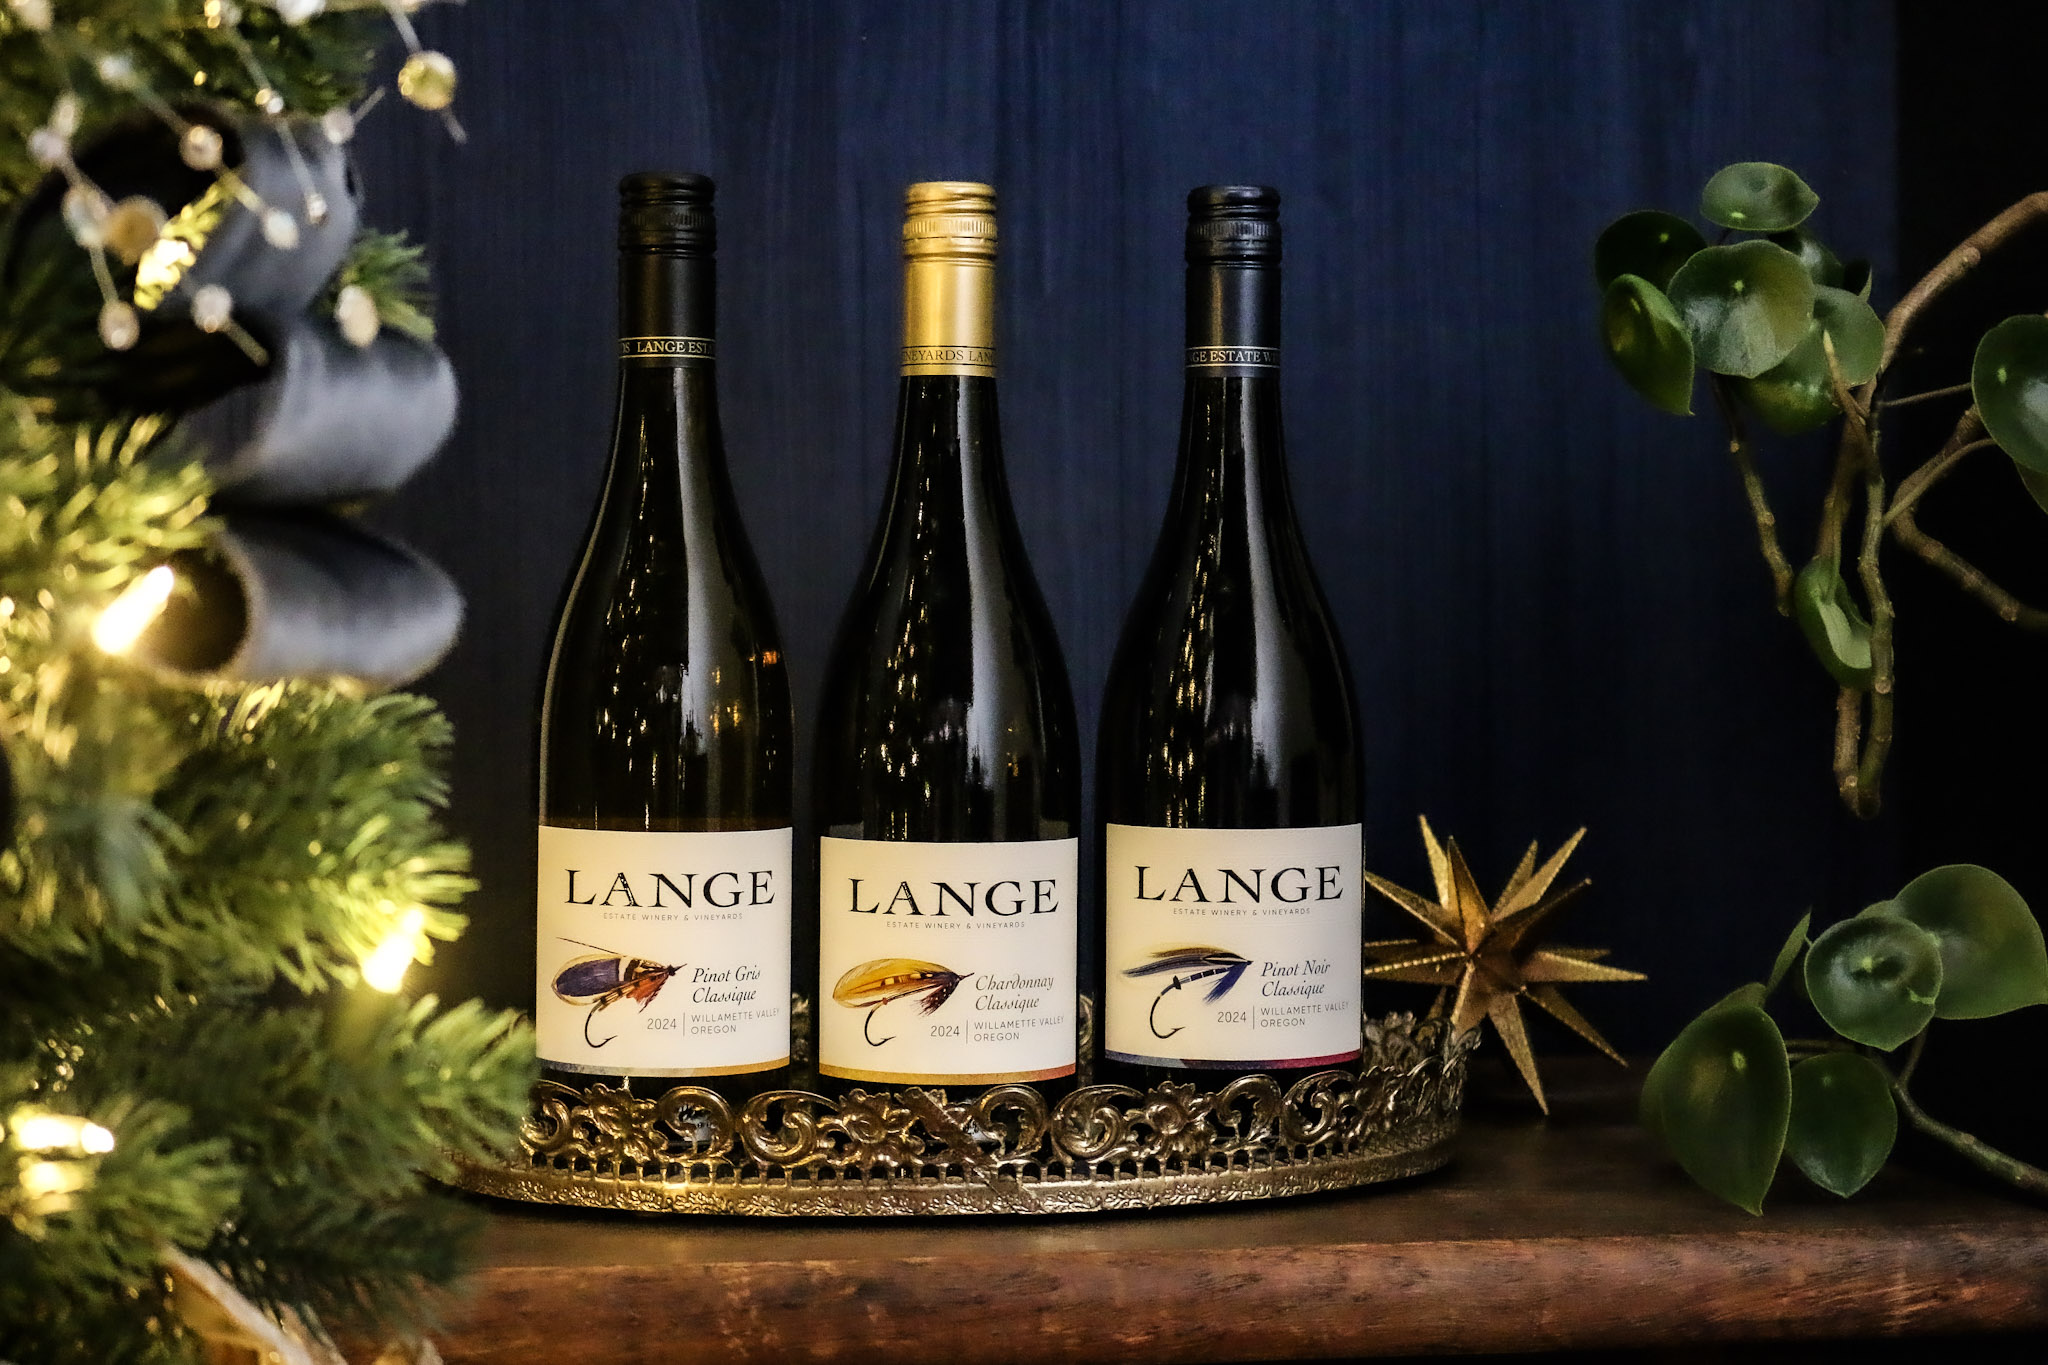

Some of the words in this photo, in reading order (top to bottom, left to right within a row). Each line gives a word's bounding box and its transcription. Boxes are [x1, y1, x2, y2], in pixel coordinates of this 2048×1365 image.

[637, 340, 686, 353] LANGE
[1210, 350, 1260, 362] ESTATE
[564, 868, 776, 908] LANGE
[1134, 865, 1343, 904] LANGE
[848, 878, 1059, 916] LANGE
[603, 912, 636, 921] ESTATE
[642, 913, 679, 922] WINERY
[694, 912, 743, 921] VINEYARDS
[1173, 908, 1206, 916] ESTATE
[1211, 908, 1247, 916] WINERY
[1252, 908, 1258, 916] &
[1262, 908, 1311, 916] VINEYARDS
[886, 921, 920, 929] ESTATE
[925, 922, 961, 930] WINERY
[966, 922, 972, 930] &
[976, 921, 1026, 929] VINEYARDS
[692, 967, 731, 984] Pinot
[735, 964, 761, 982] Gris
[1261, 960, 1300, 978] Pinot
[1302, 958, 1331, 976] Noir
[975, 972, 1054, 992] Chardonnay
[692, 985, 757, 1006] Classique
[1261, 980, 1325, 1000] Classique
[975, 993, 1040, 1014] Classique
[1260, 1004, 1322, 1016] WILLAMETTE
[1324, 1001, 1349, 1012] VALLEY
[690, 1012, 753, 1024] WILLAMETTE
[756, 1008, 780, 1018] VALLEY
[974, 1018, 1036, 1030] WILLAMETTE
[1038, 1016, 1064, 1026] VALLEY
[1217, 1011, 1247, 1023] 2024
[1260, 1018, 1306, 1028] OREGON
[646, 1018, 677, 1030] 2024
[690, 1025, 737, 1035] OREGON
[930, 1025, 960, 1037] 2024
[974, 1032, 1020, 1042] OREGON
